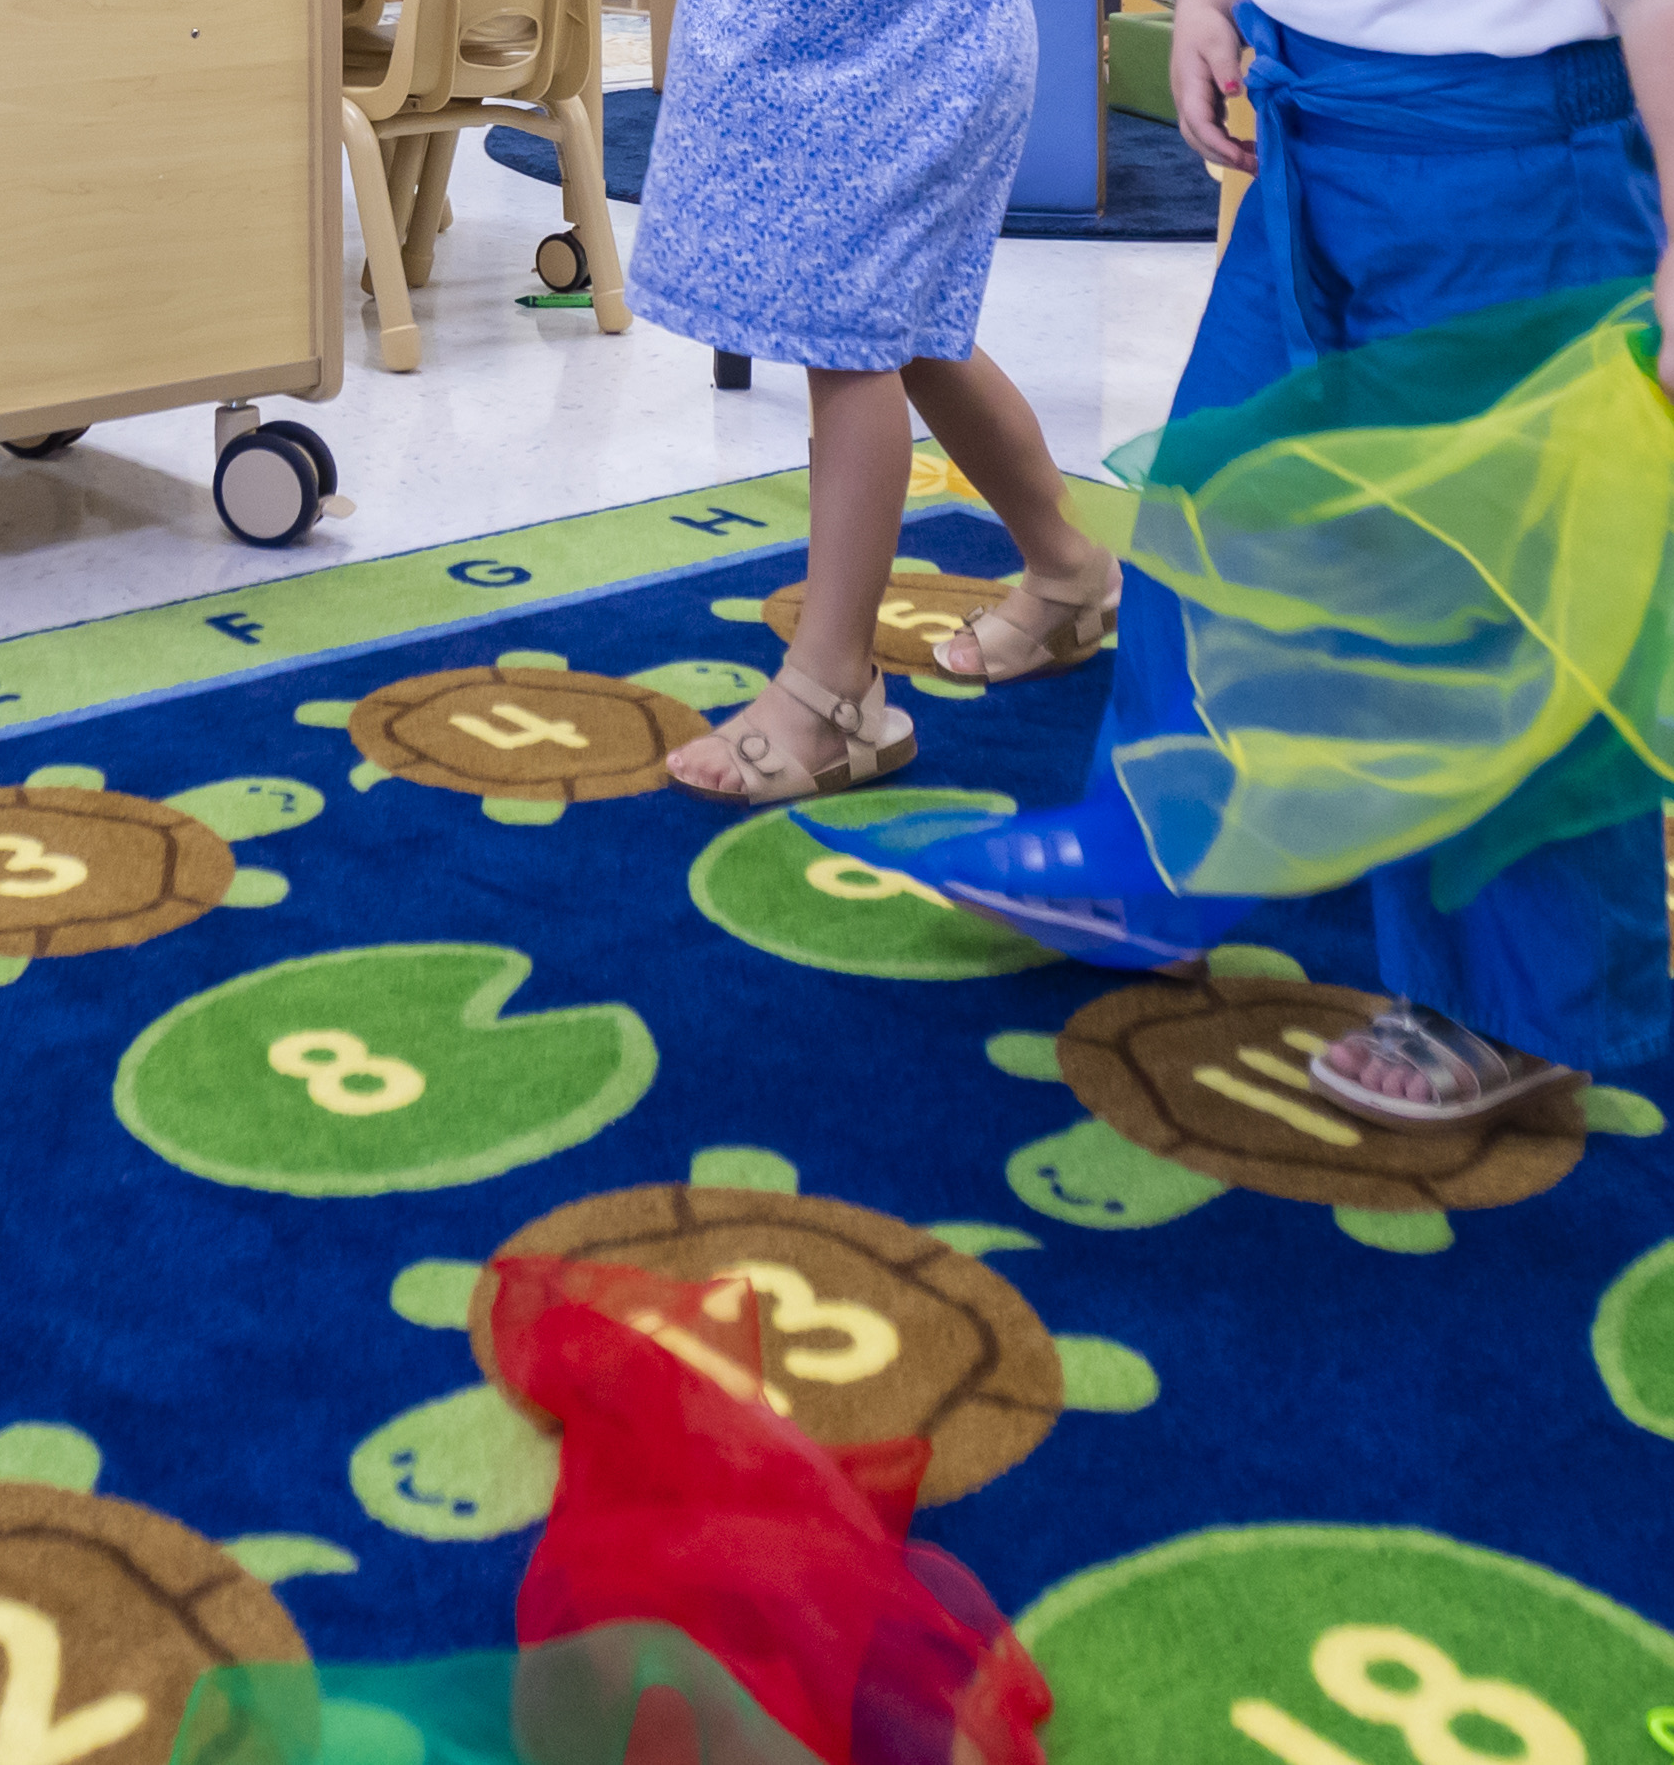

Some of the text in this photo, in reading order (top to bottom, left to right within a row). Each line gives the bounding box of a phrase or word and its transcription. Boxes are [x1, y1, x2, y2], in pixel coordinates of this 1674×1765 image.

[204, 612, 265, 644] F
[447, 559, 532, 587] G
[671, 507, 768, 535] H
[448, 704, 589, 748] 4
[267, 1030, 426, 1116] 8
[1230, 1625, 1587, 1765] 18
